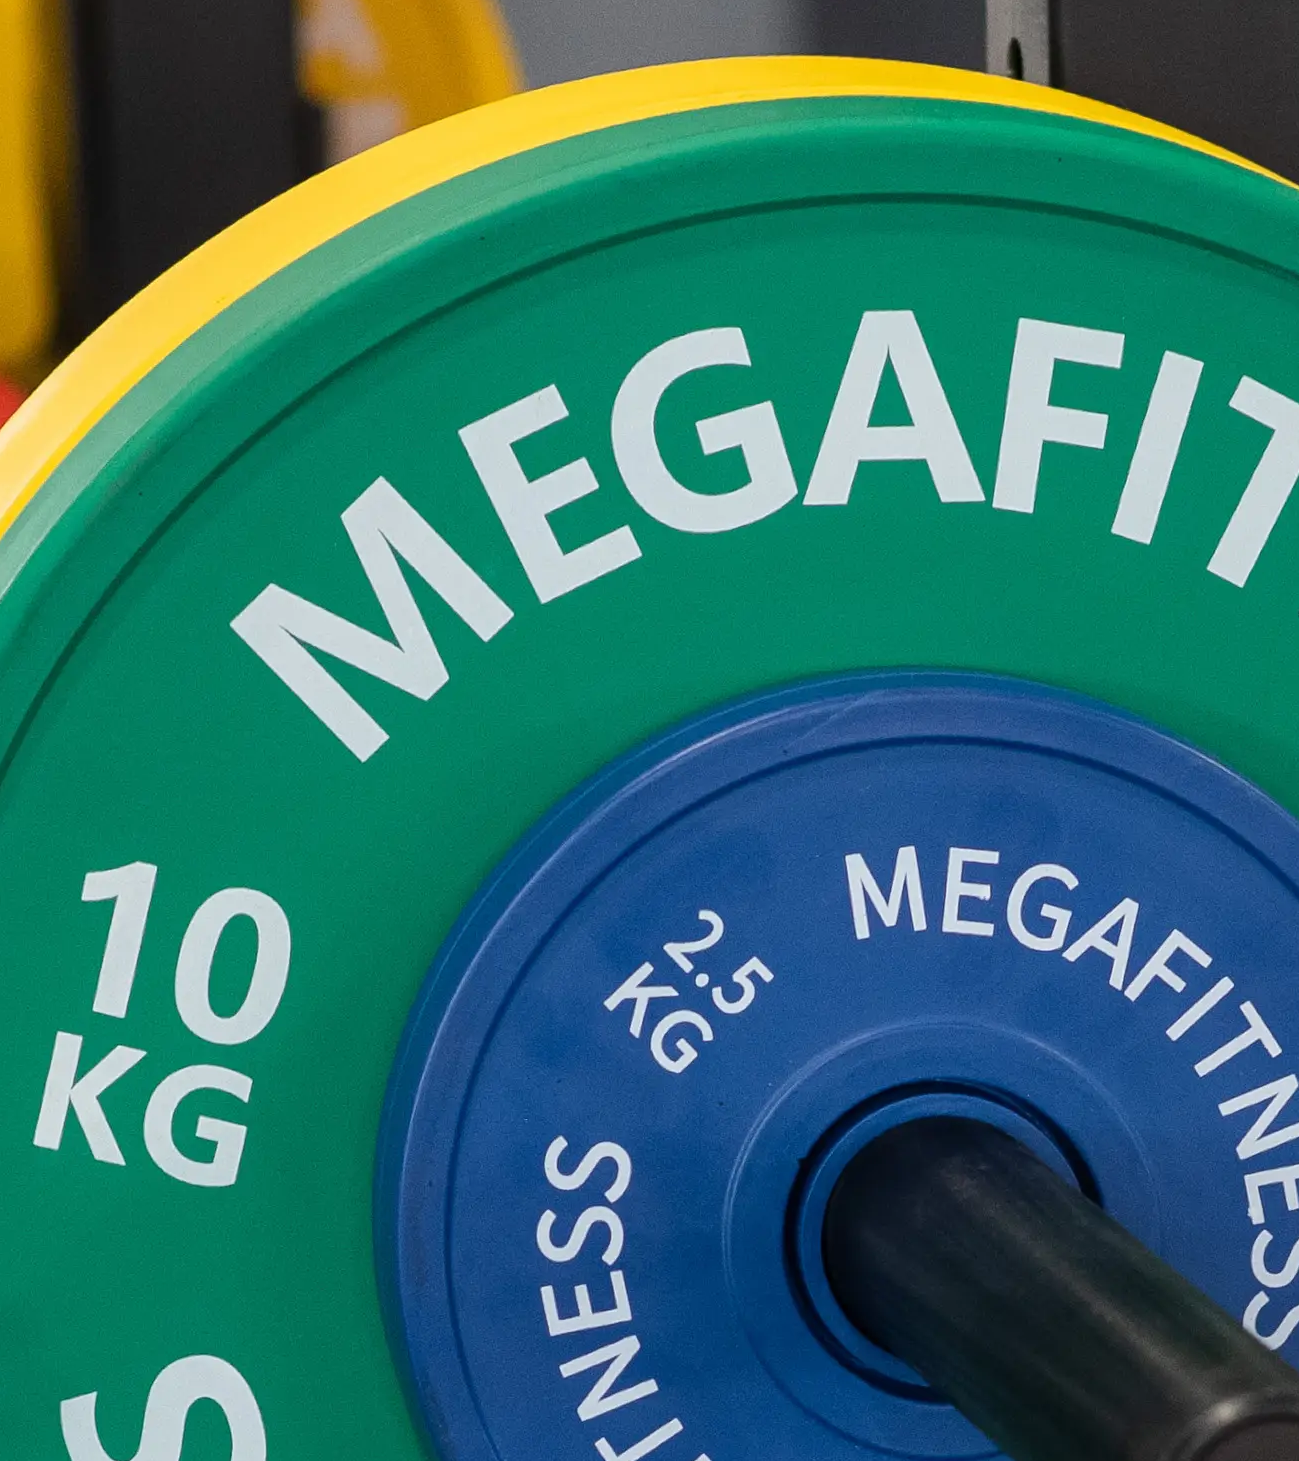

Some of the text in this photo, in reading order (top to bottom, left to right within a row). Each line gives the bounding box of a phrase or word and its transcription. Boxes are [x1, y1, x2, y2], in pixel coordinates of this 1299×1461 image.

[80, 860, 293, 1046] 10
[602, 960, 715, 1075] KG
[662, 908, 776, 1015] 2.5
[32, 1030, 254, 1188] KG
